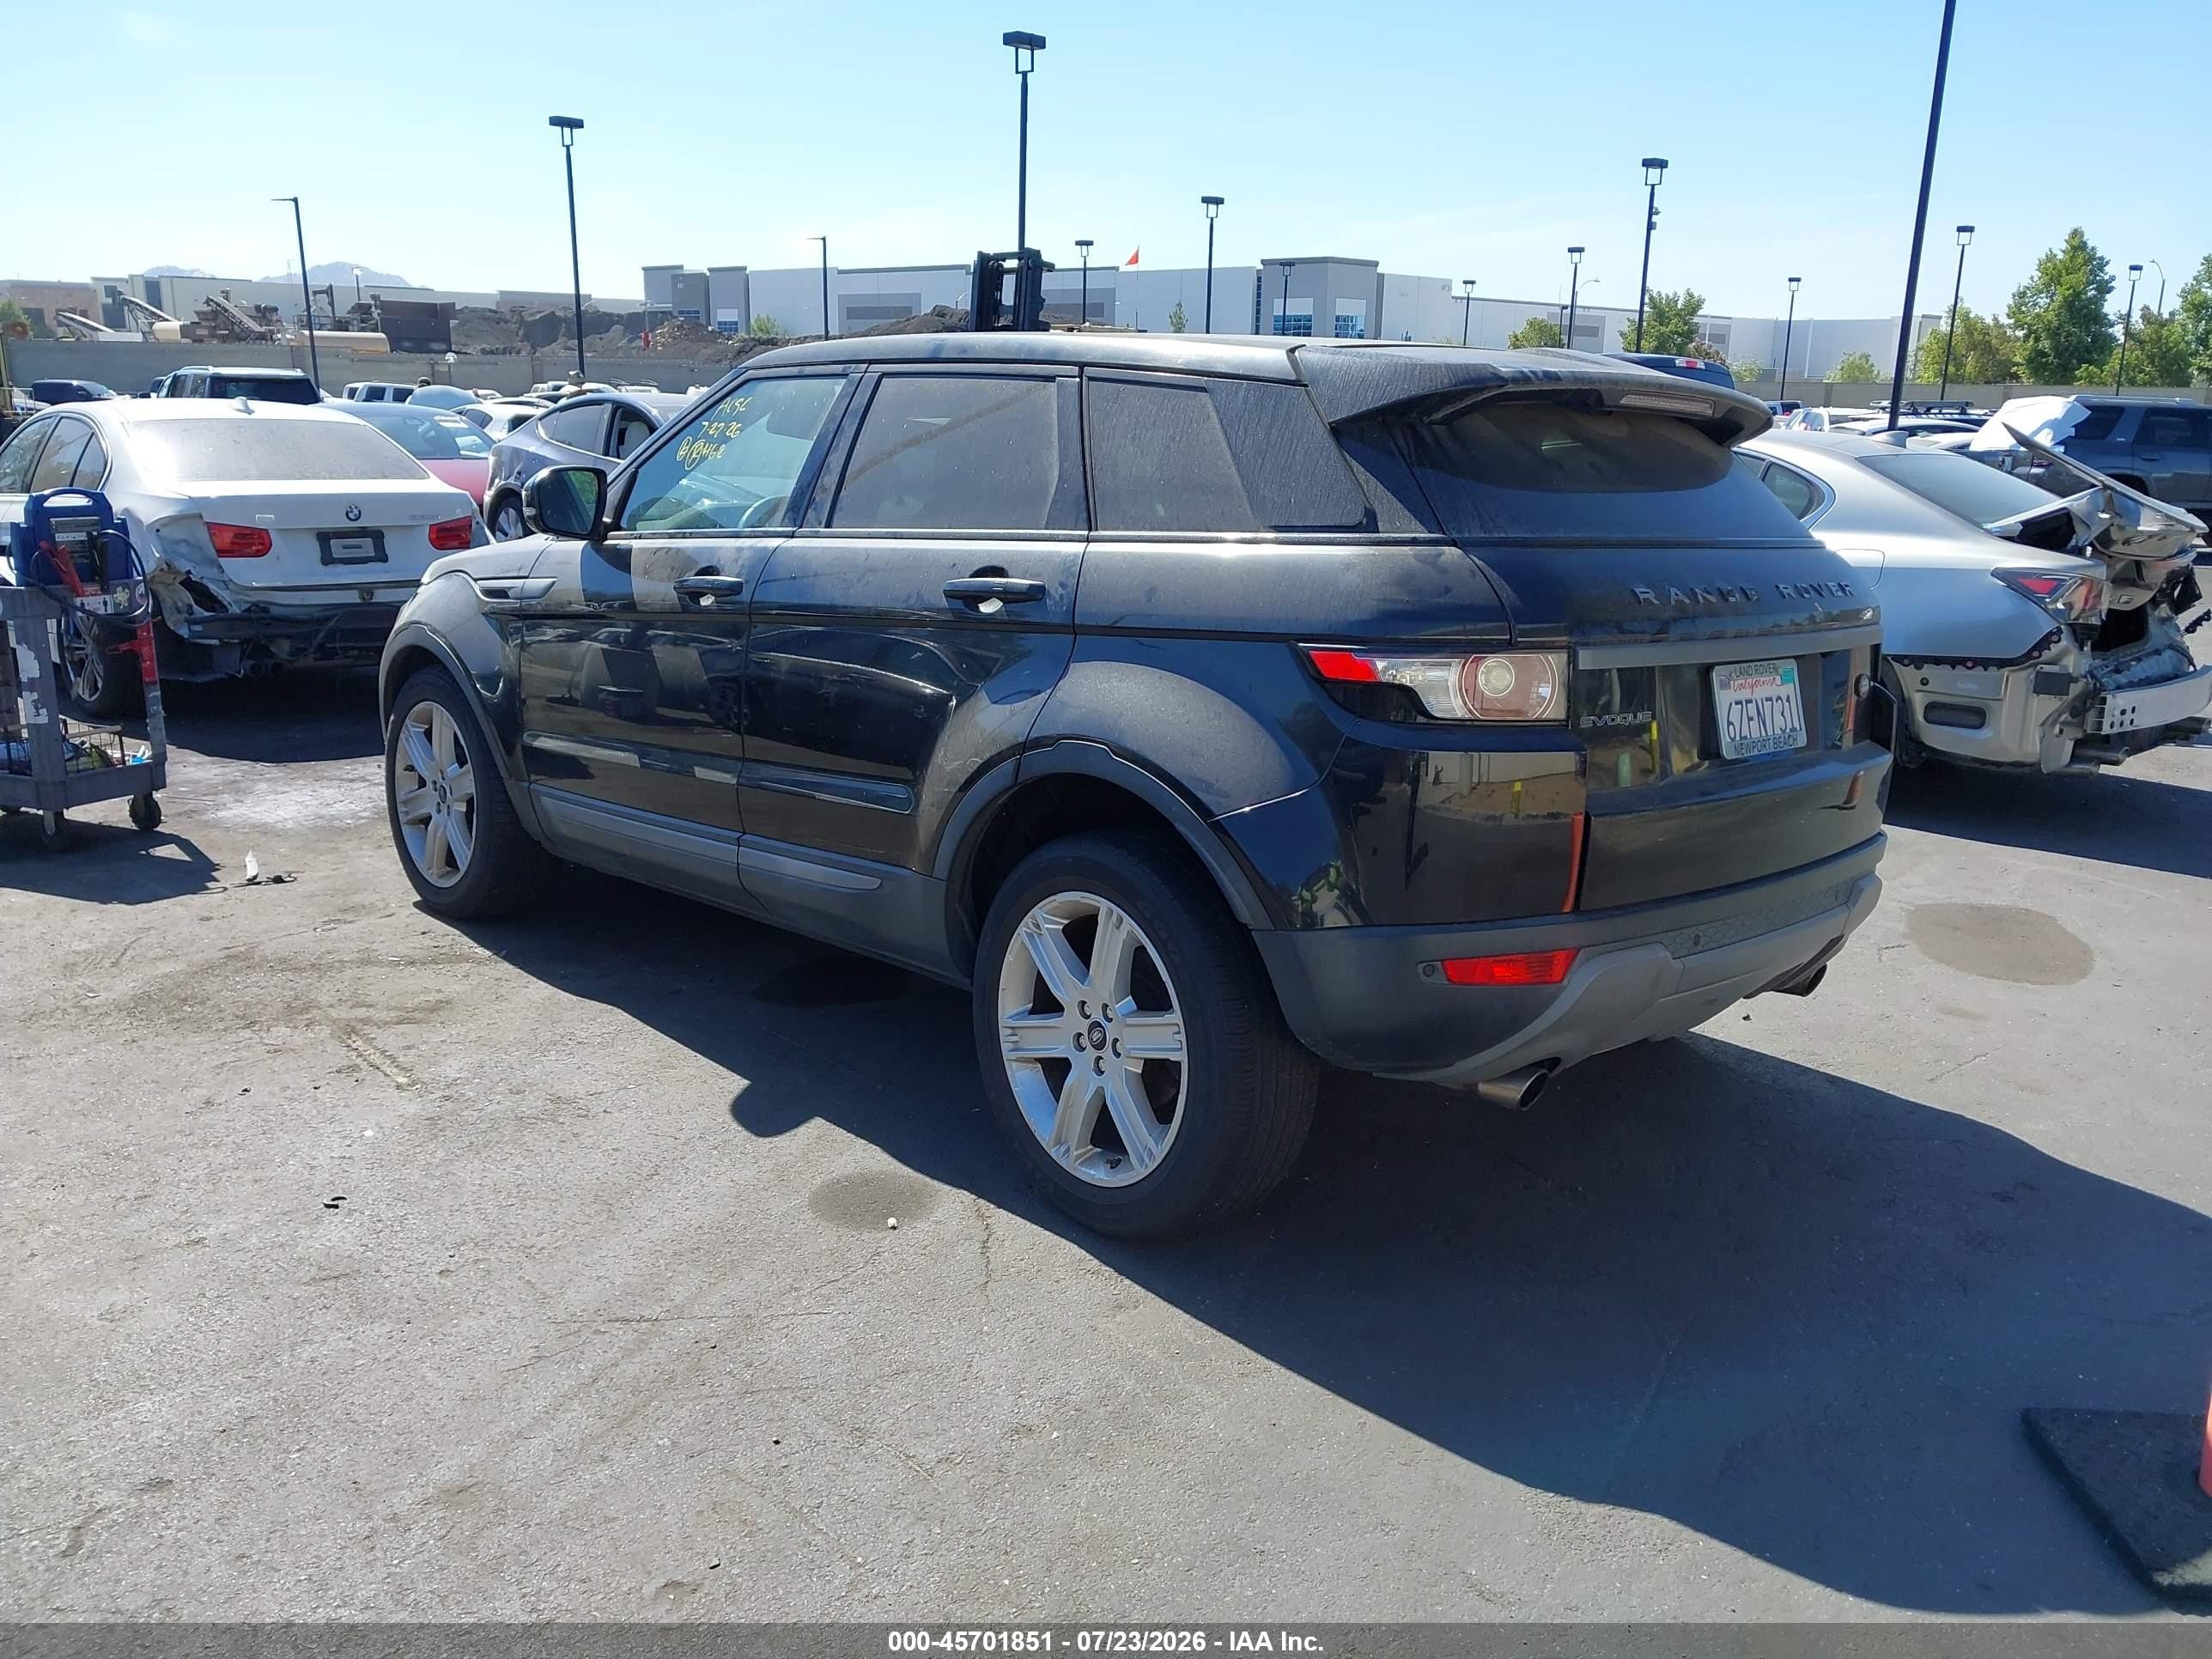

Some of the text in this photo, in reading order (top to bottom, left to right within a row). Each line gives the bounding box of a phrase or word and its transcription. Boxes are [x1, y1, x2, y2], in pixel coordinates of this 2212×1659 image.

[1632, 581, 1856, 605] RANGE ROVER
[1735, 662, 1778, 678] LAND ROVER
[1731, 677, 1782, 696] California
[1580, 711, 1652, 728] EVOQUE
[1726, 694, 1798, 743] 6ZFN731
[1735, 733, 1799, 756] NEWPORT BEACH
